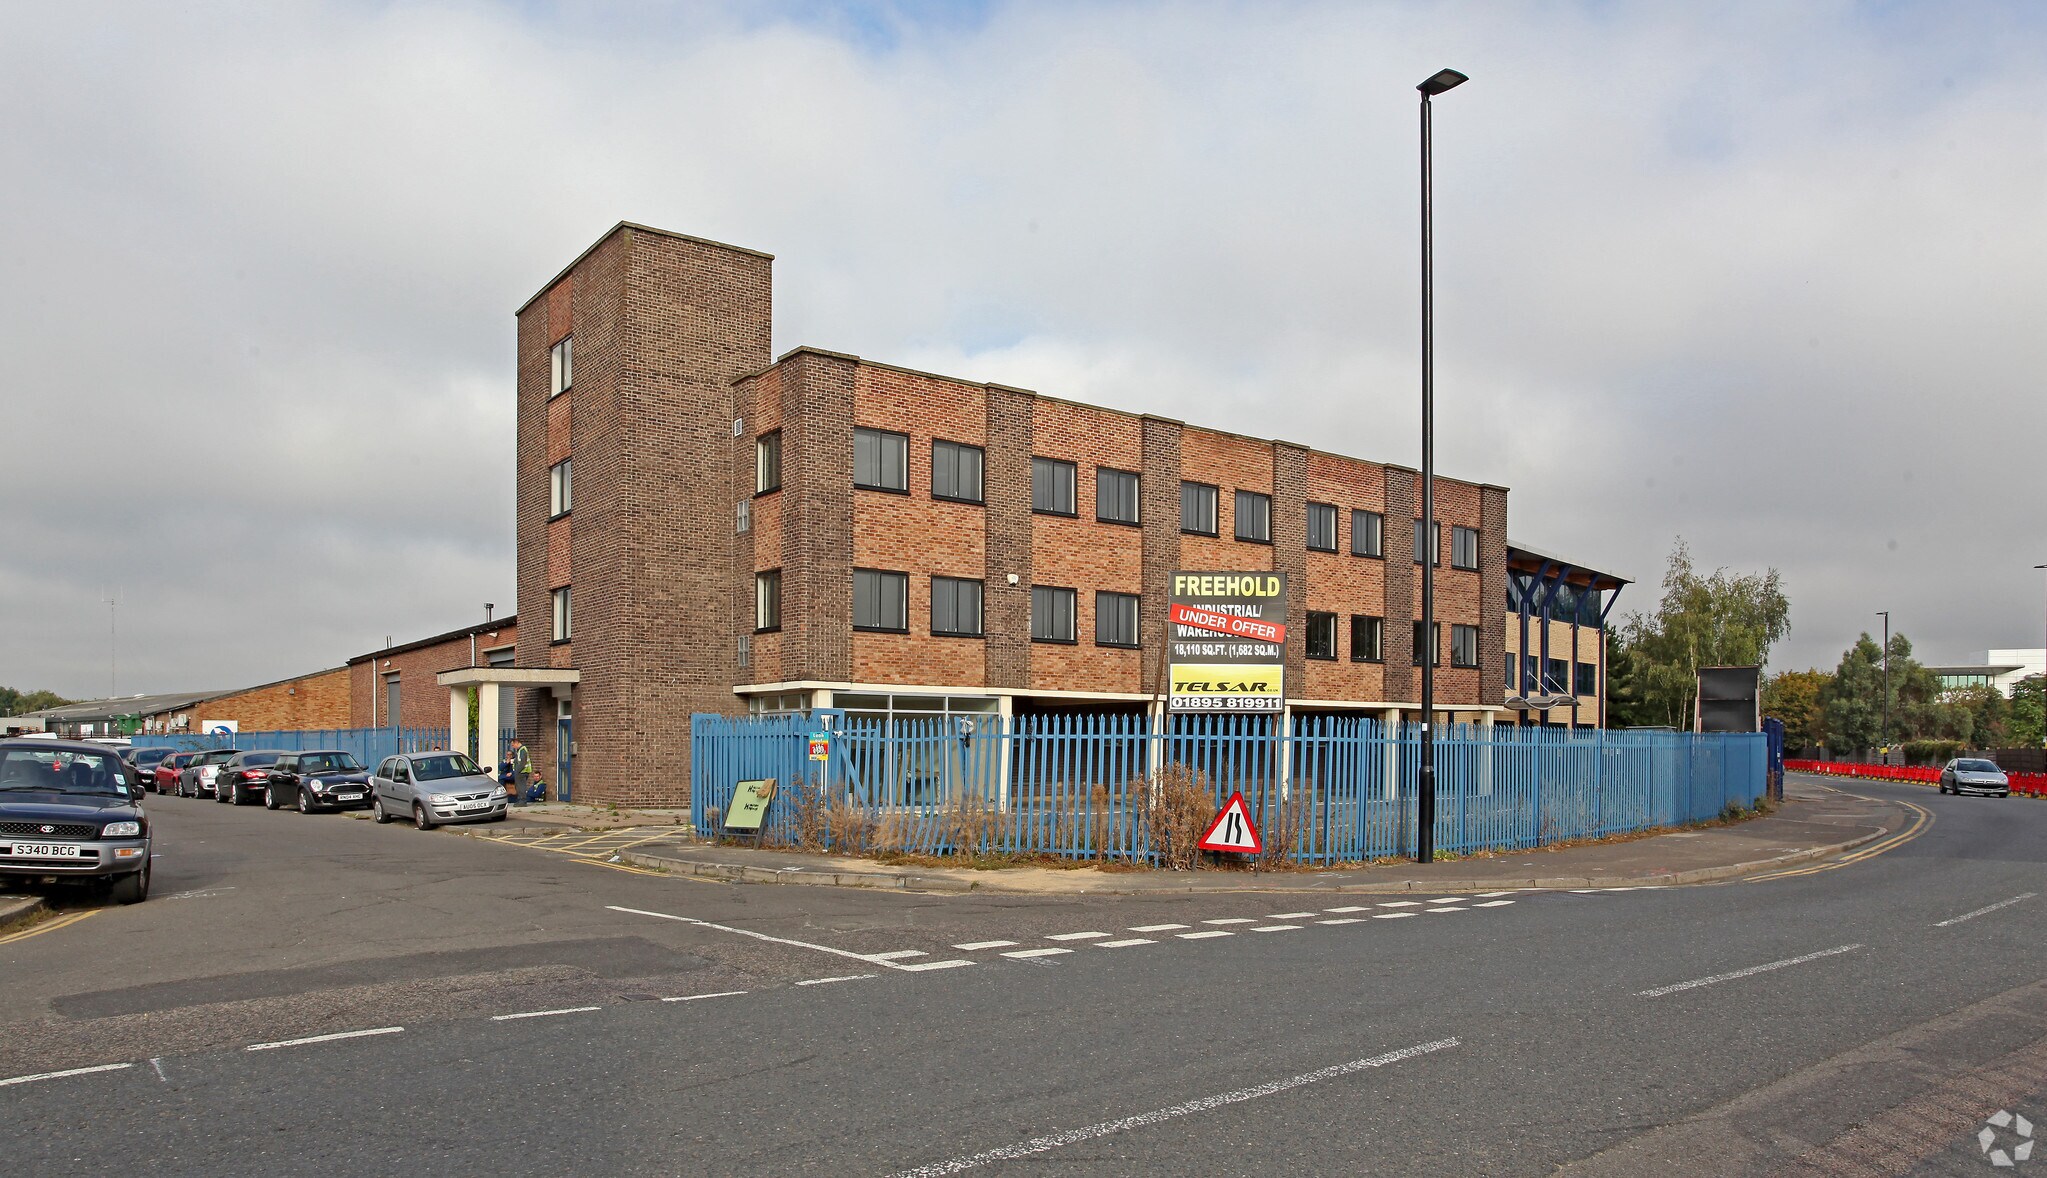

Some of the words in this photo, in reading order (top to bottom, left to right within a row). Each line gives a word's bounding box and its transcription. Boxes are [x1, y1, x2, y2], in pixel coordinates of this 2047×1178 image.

[1175, 576, 1280, 597] FREEHOLD
[1193, 604, 1263, 618] USTRIAL/
[1179, 609, 1227, 629] UNDER
[1232, 620, 1276, 638] OFFER
[1175, 644, 1200, 657] 18,110
[1202, 644, 1227, 656] SQ.FT.
[1229, 645, 1252, 658] (1,682
[1254, 645, 1279, 658] SQ.M.)
[1175, 682, 1268, 692] TELSAR
[1172, 697, 1223, 708] 01895
[1227, 697, 1281, 708] 819911
[17, 845, 49, 855] S340
[52, 846, 75, 856] BCG
